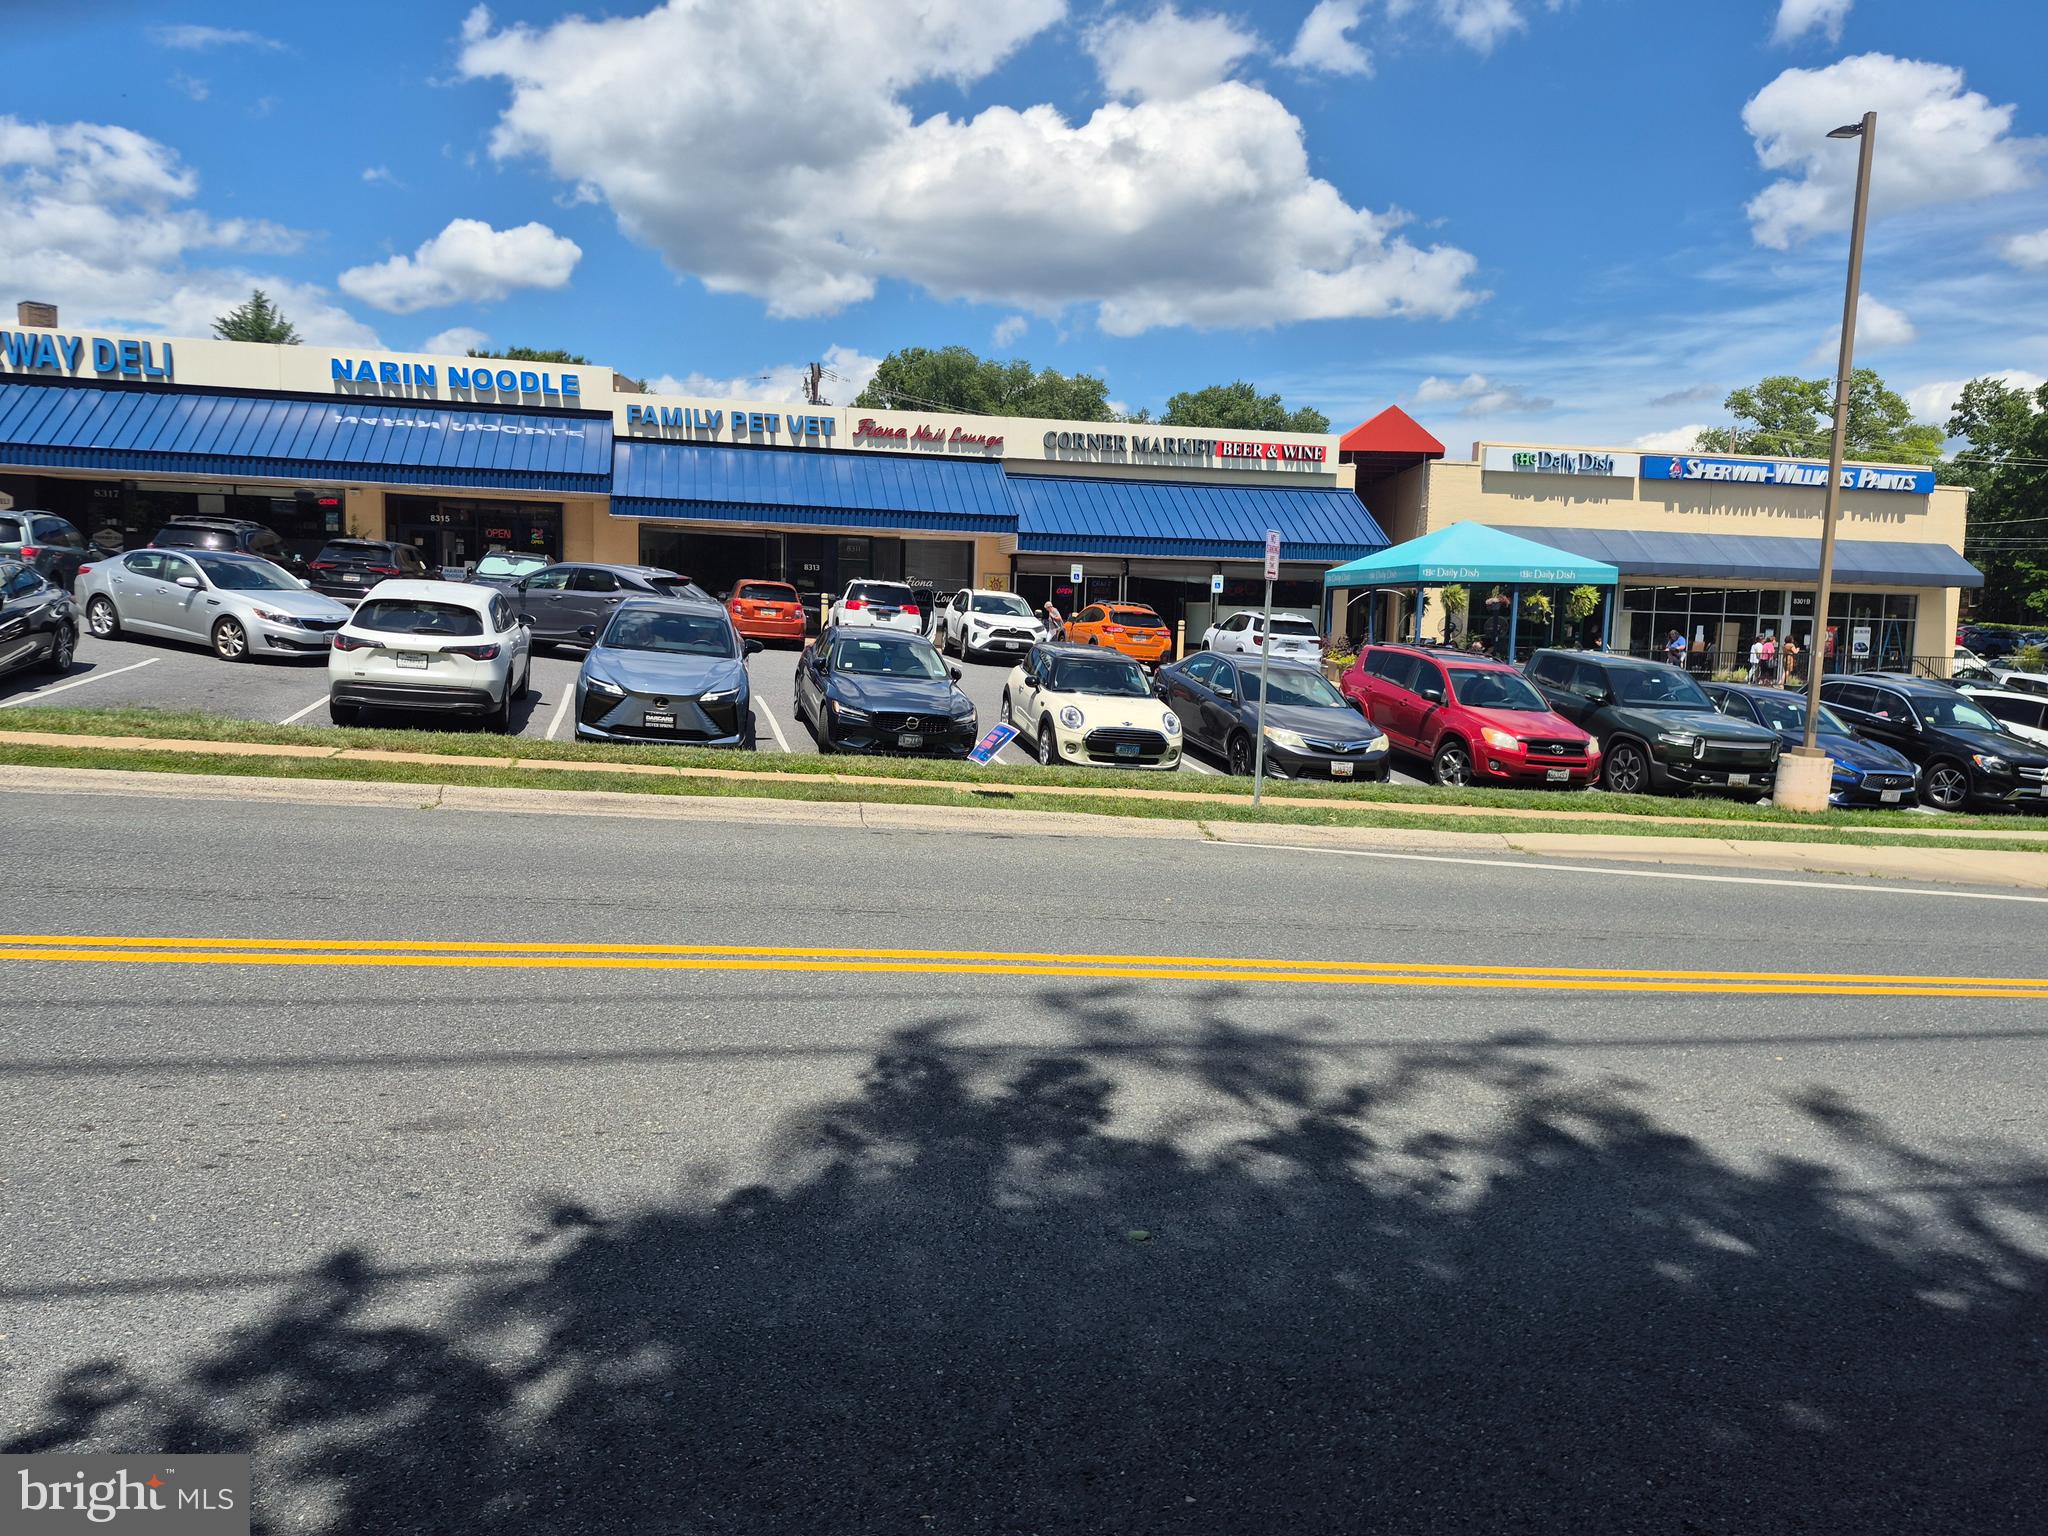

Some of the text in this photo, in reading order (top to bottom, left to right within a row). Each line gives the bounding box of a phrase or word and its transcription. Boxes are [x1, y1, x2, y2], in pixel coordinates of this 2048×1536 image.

[92, 337, 173, 377] DELI
[331, 358, 581, 395] NARIN NOODLE
[626, 404, 835, 436] FAMILY PET VET
[852, 418, 1004, 448] Fiona Nail Lounge
[1043, 431, 1217, 456] CORNER MARKET
[1223, 442, 1323, 461] BEER & WINE
[1538, 451, 1577, 473] Daily
[1578, 453, 1615, 471] Dish
[1857, 469, 1917, 491] PAINTS
[430, 514, 450, 523] 8315
[486, 528, 511, 538] OPEN
[803, 563, 820, 571] 8313
[1437, 567, 1458, 578] Daily
[1460, 567, 1480, 577] Dish
[1534, 570, 1555, 580] Daily
[1556, 570, 1576, 579] Dish
[905, 576, 934, 587] Fiona
[1056, 587, 1073, 595] OPEN
